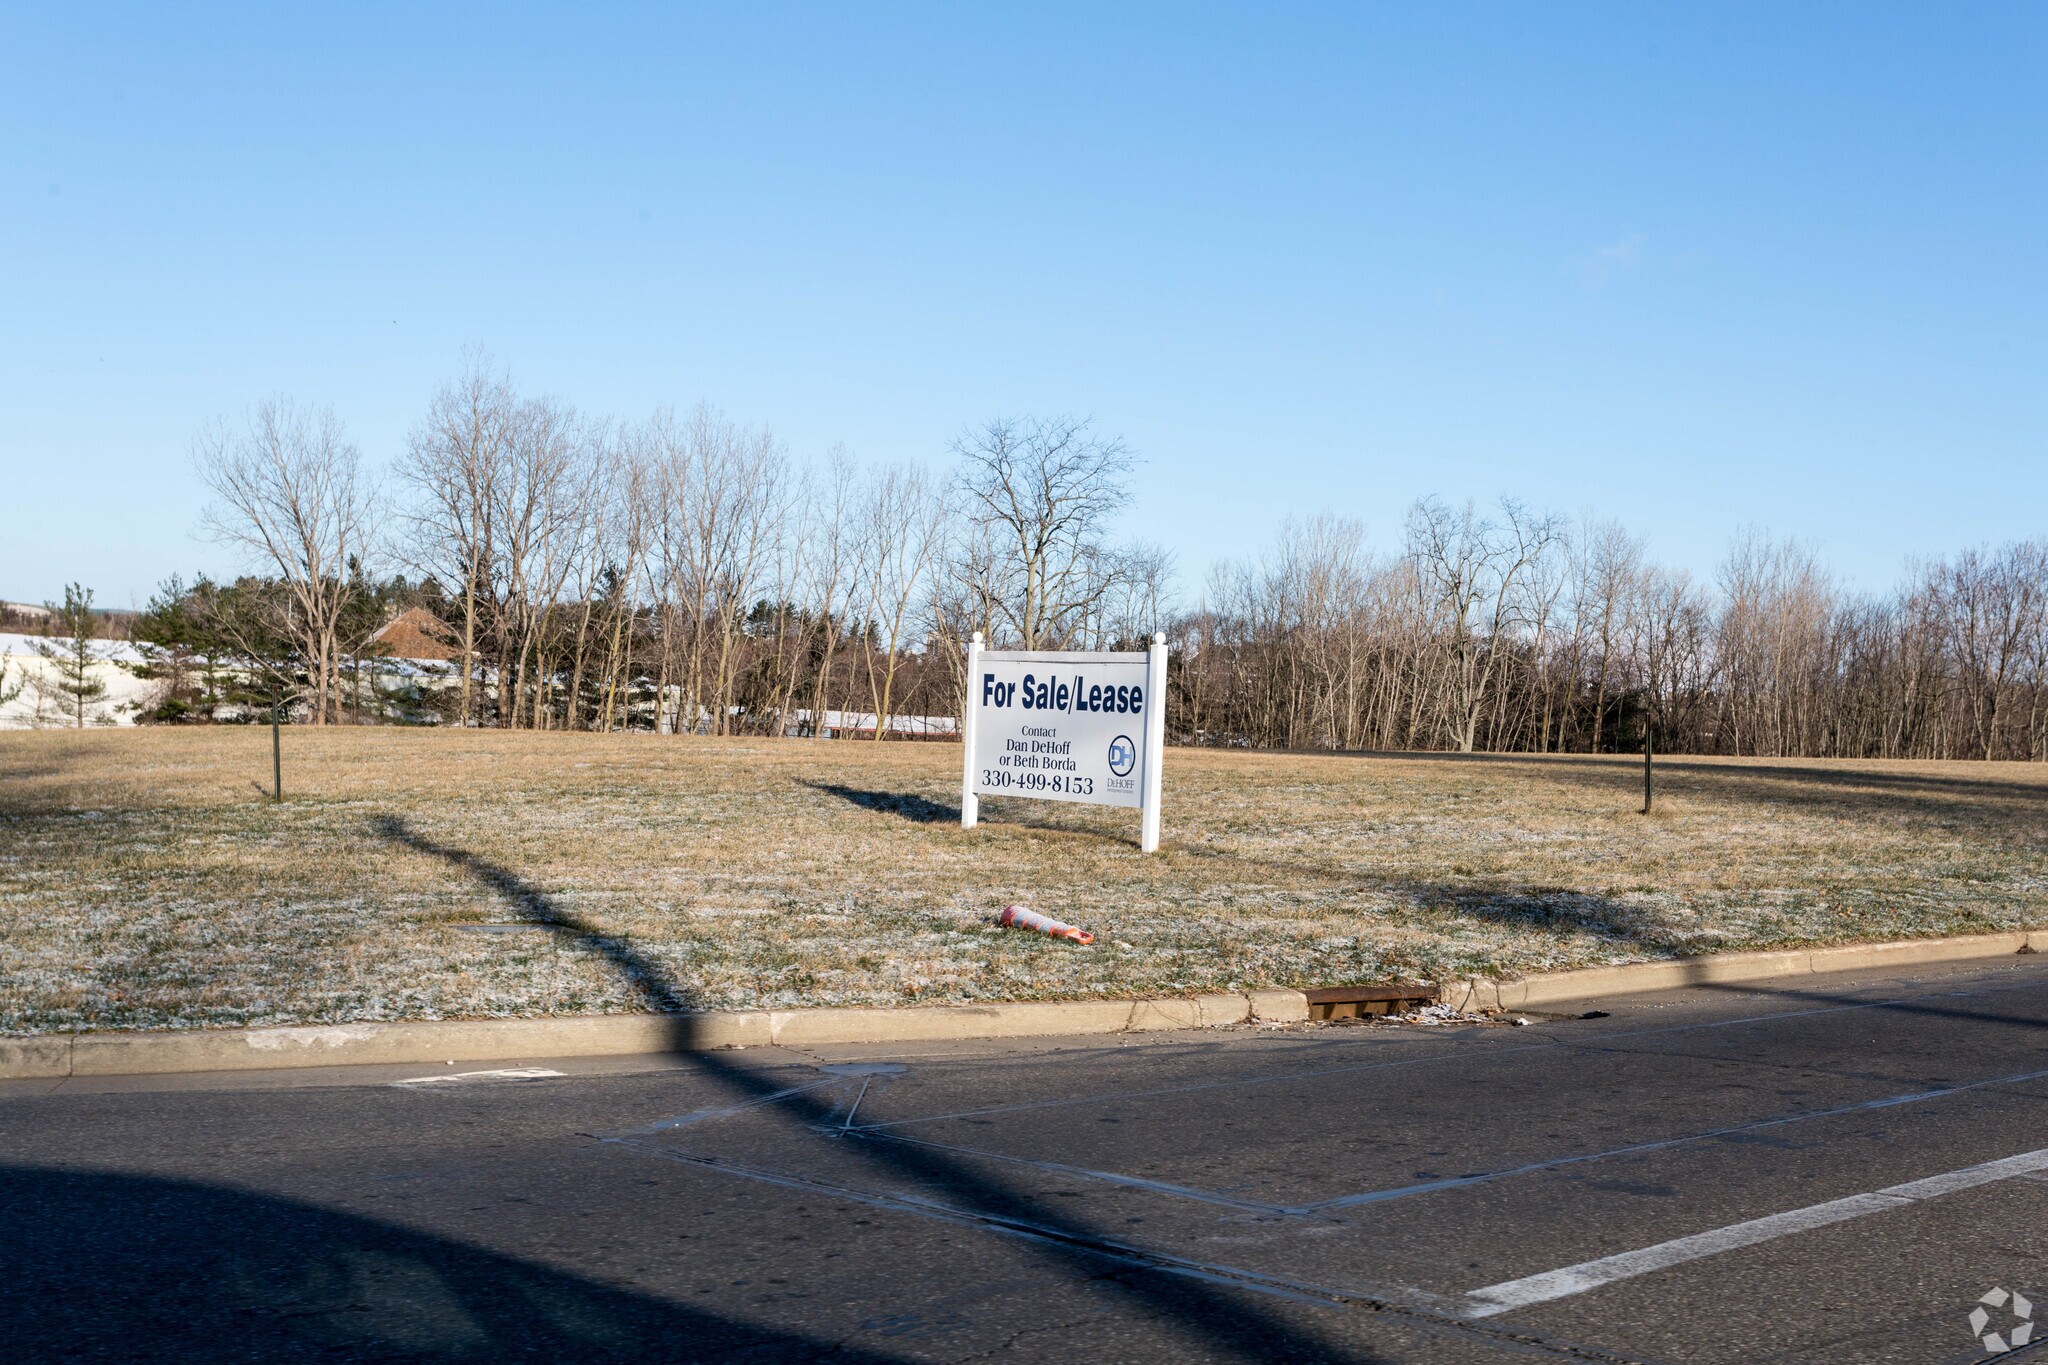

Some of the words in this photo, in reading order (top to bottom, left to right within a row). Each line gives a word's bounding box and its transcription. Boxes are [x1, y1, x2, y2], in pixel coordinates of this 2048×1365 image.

[983, 673, 1016, 707] For
[1022, 674, 1143, 714] Sale/Lease
[1021, 725, 1056, 737] Contact
[1006, 739, 1028, 752] Dan
[1031, 741, 1071, 755] DeHoff
[999, 757, 1010, 766] or
[1013, 755, 1039, 768] Beth
[1042, 758, 1076, 771] Borda
